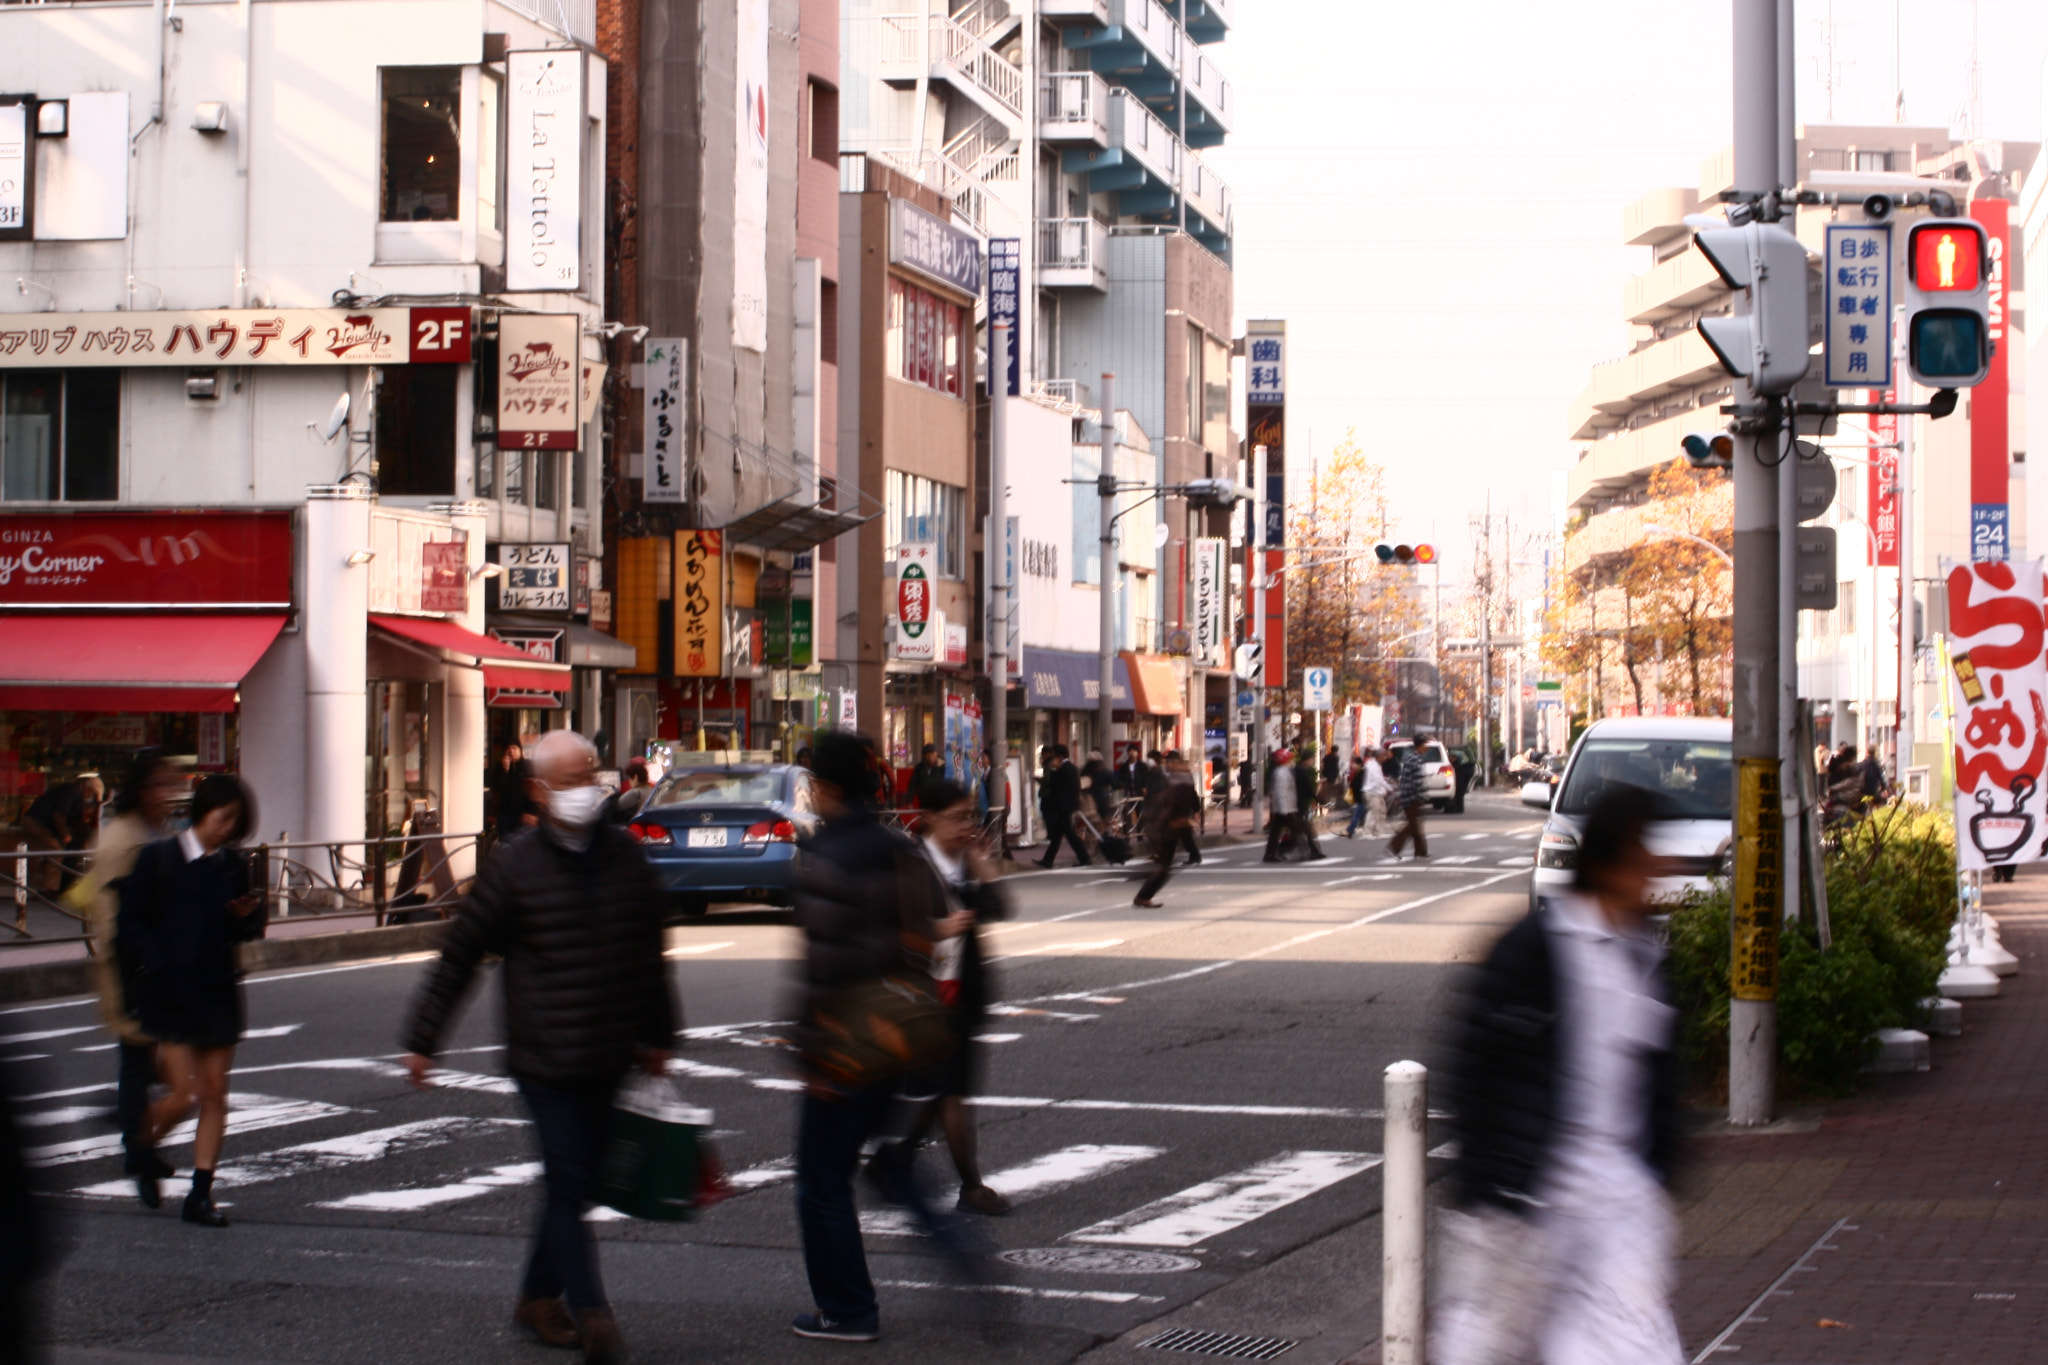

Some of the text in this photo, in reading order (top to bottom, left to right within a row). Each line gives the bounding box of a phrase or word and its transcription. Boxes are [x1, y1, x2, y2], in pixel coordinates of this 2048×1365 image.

[532, 110, 555, 267] La Tettolo
[1837, 237, 1858, 316] 自転車
[1859, 237, 1880, 316] 歩行者
[0, 326, 77, 355] アリブ
[163, 318, 316, 360] ハウディ
[326, 324, 391, 353] Howdy
[417, 320, 464, 350] 2F
[1848, 323, 1869, 374] 専用
[507, 353, 570, 377] Howdy
[1251, 339, 1282, 390] 歯科
[504, 397, 570, 415] ハウディ
[523, 432, 549, 446] 2F
[2, 531, 53, 543] GINZA
[1975, 523, 2005, 545] 24
[510, 547, 560, 564] うどん
[511, 567, 558, 586] そば
[503, 590, 568, 608] カレーライス
